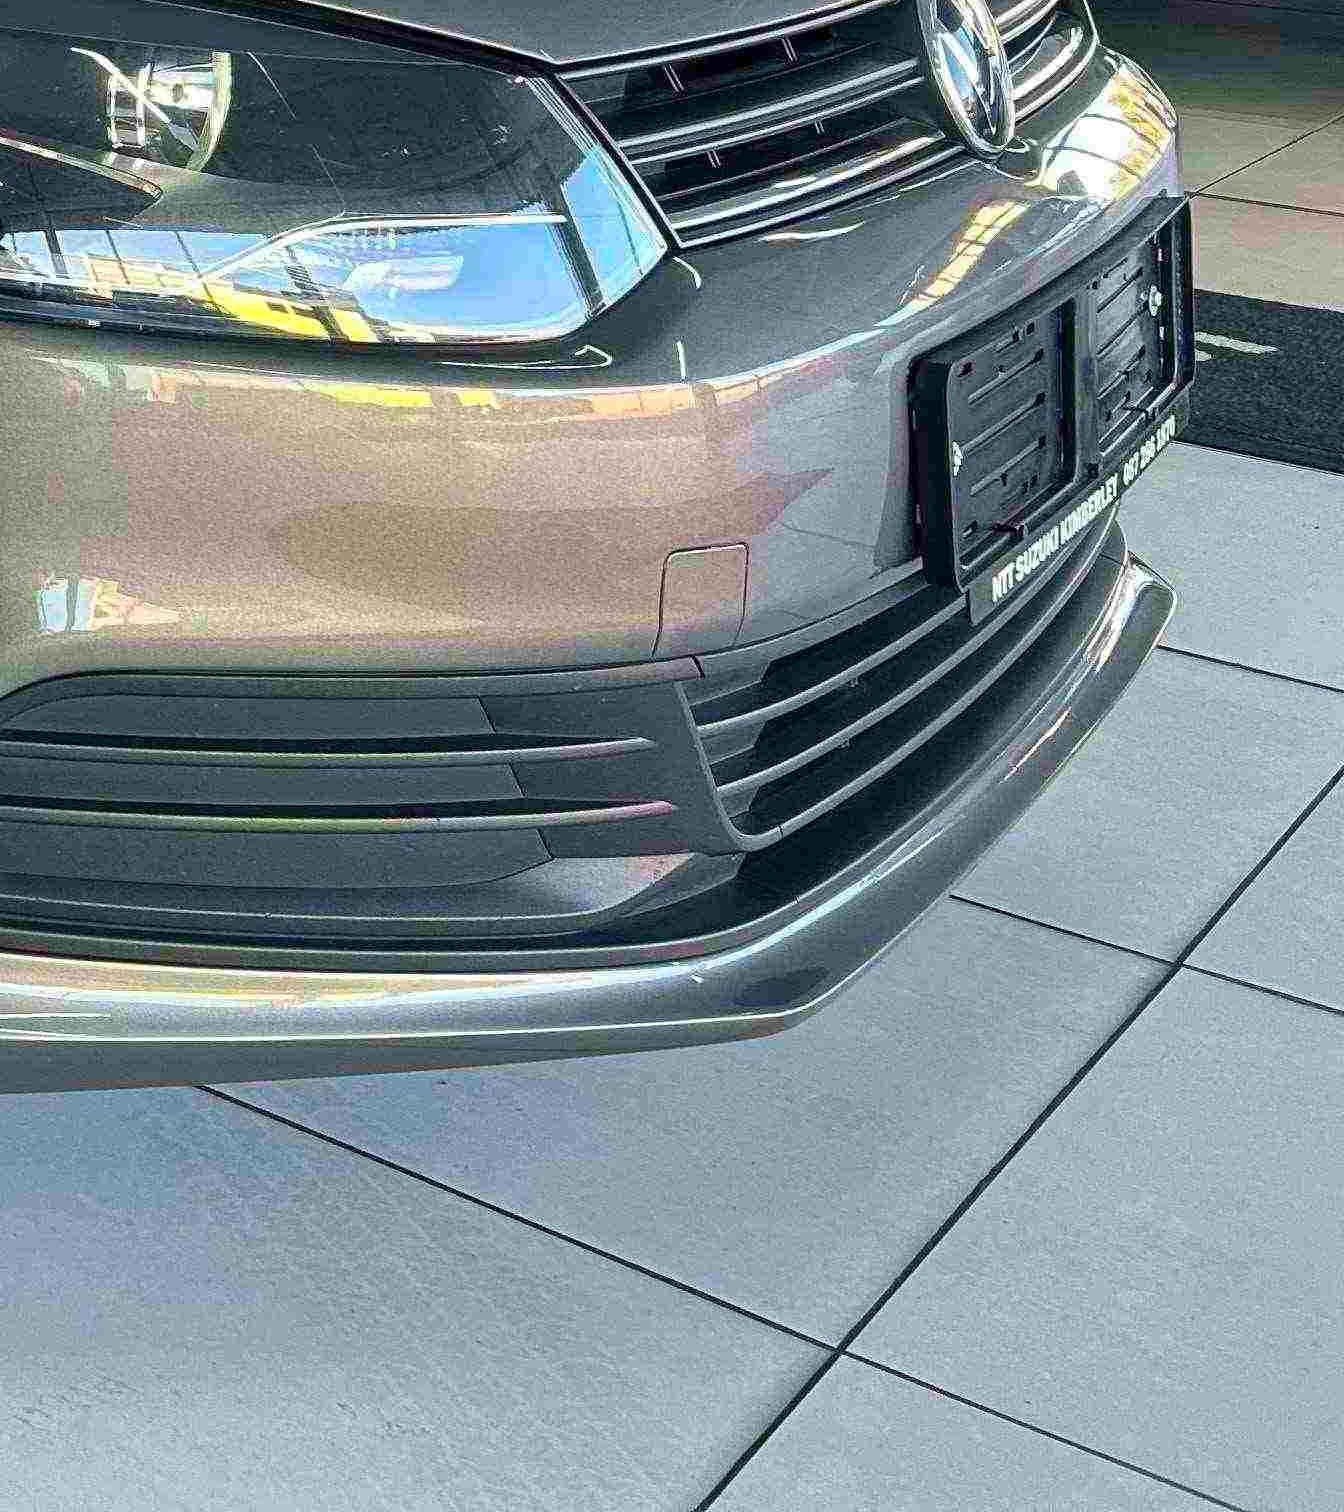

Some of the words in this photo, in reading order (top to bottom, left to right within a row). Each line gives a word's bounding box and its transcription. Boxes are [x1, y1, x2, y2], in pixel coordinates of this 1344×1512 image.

[992, 560, 1015, 603] NTT
[1015, 524, 1059, 582] SUZUKI
[1060, 473, 1118, 545] KIMBERLEY
